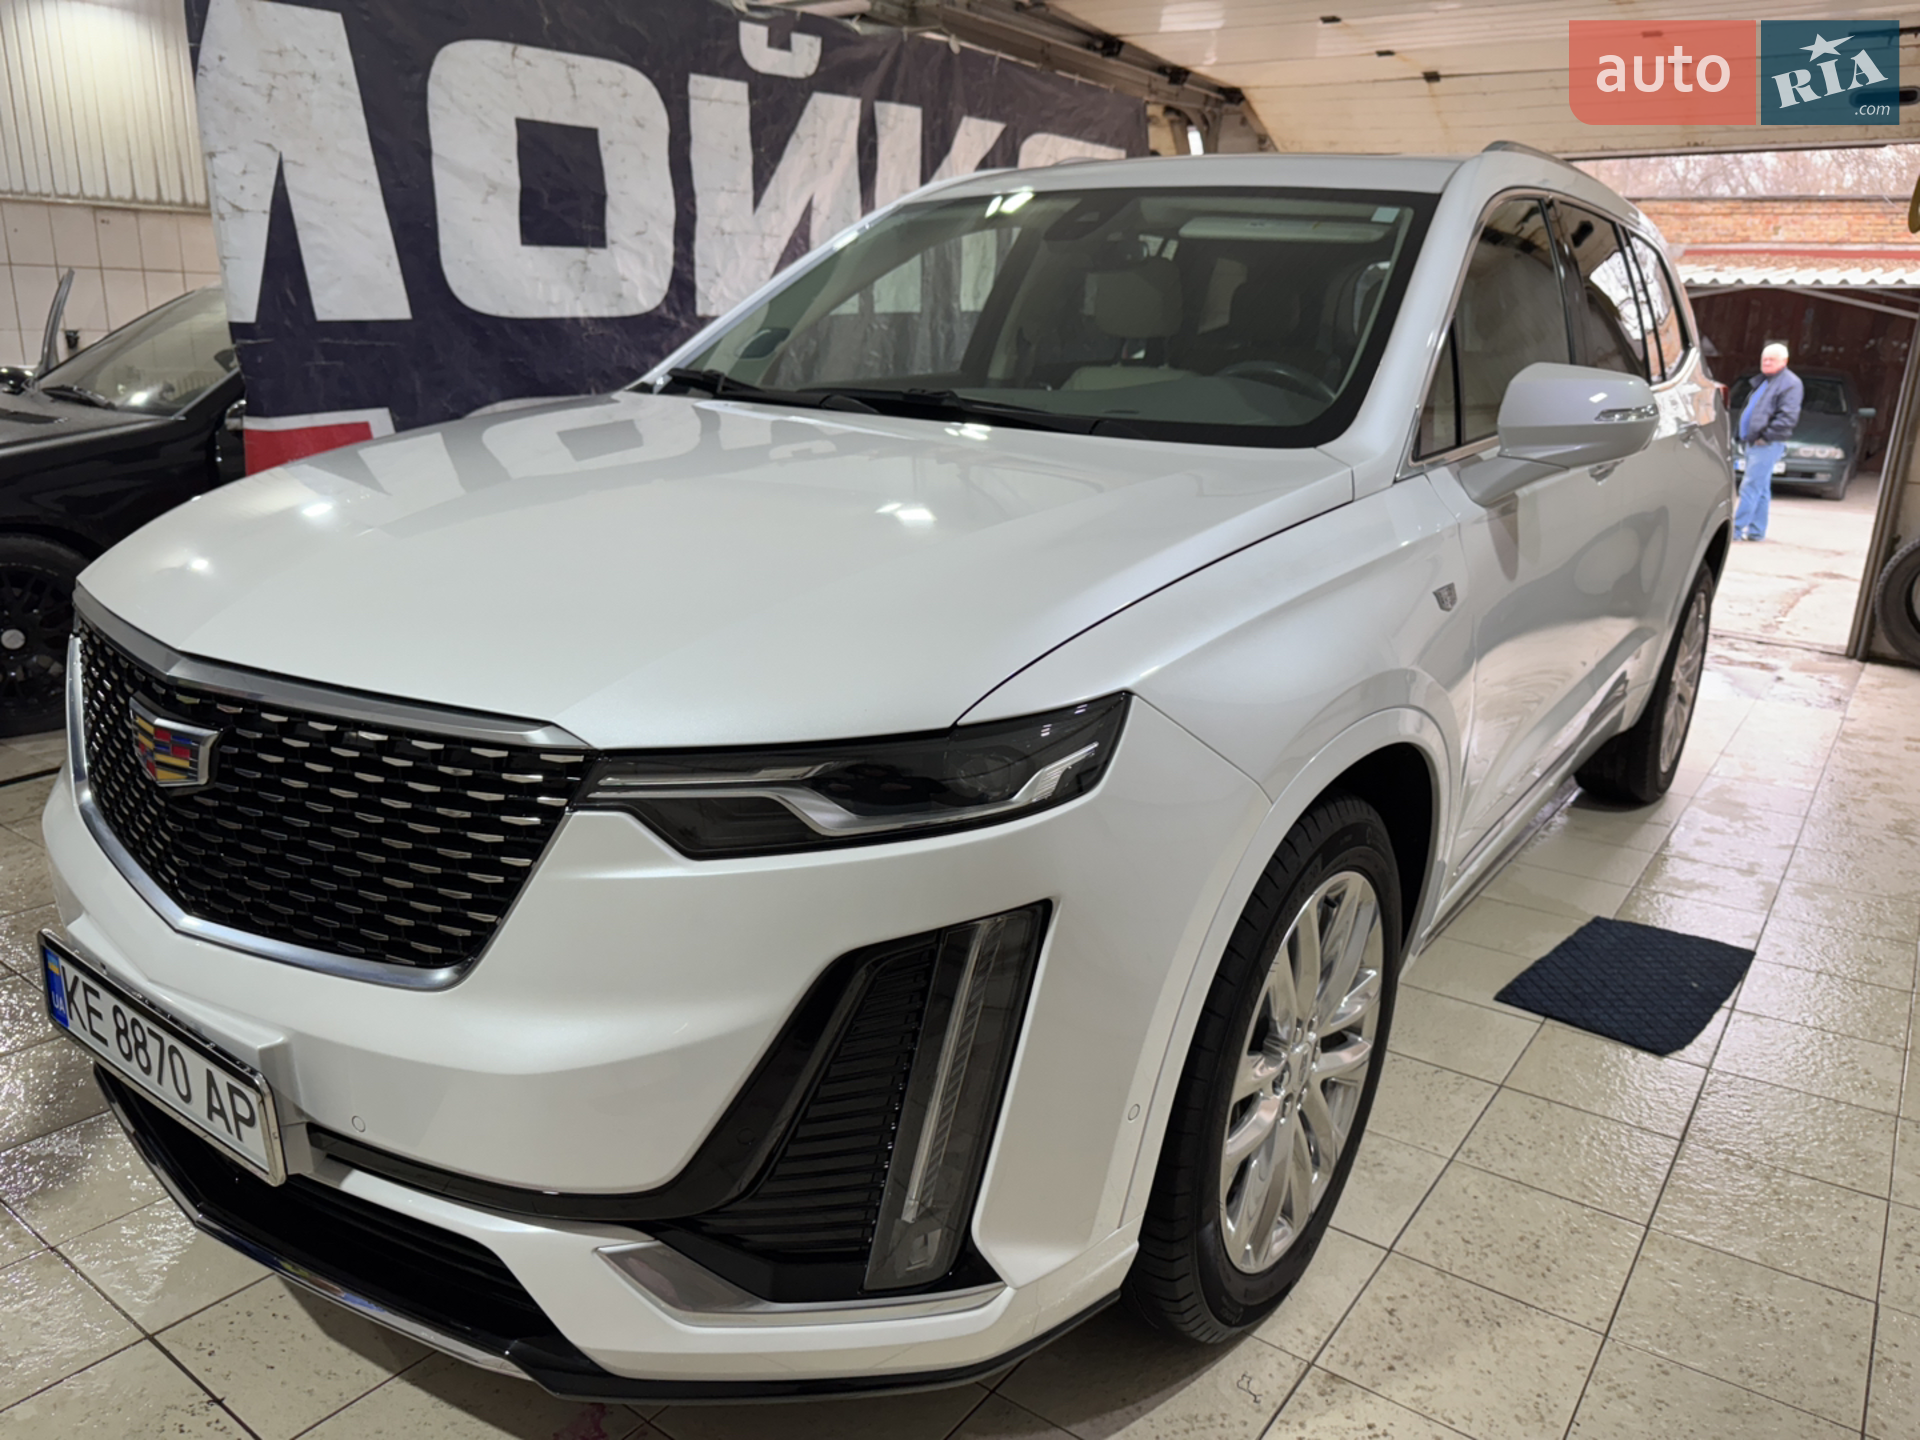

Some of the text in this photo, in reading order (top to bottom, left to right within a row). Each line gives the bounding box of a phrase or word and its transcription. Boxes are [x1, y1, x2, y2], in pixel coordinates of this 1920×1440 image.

[196, 0, 1127, 323] ЛОЙК
[51, 990, 67, 1015] UA
[61, 965, 256, 1143] KE 8870 AP
